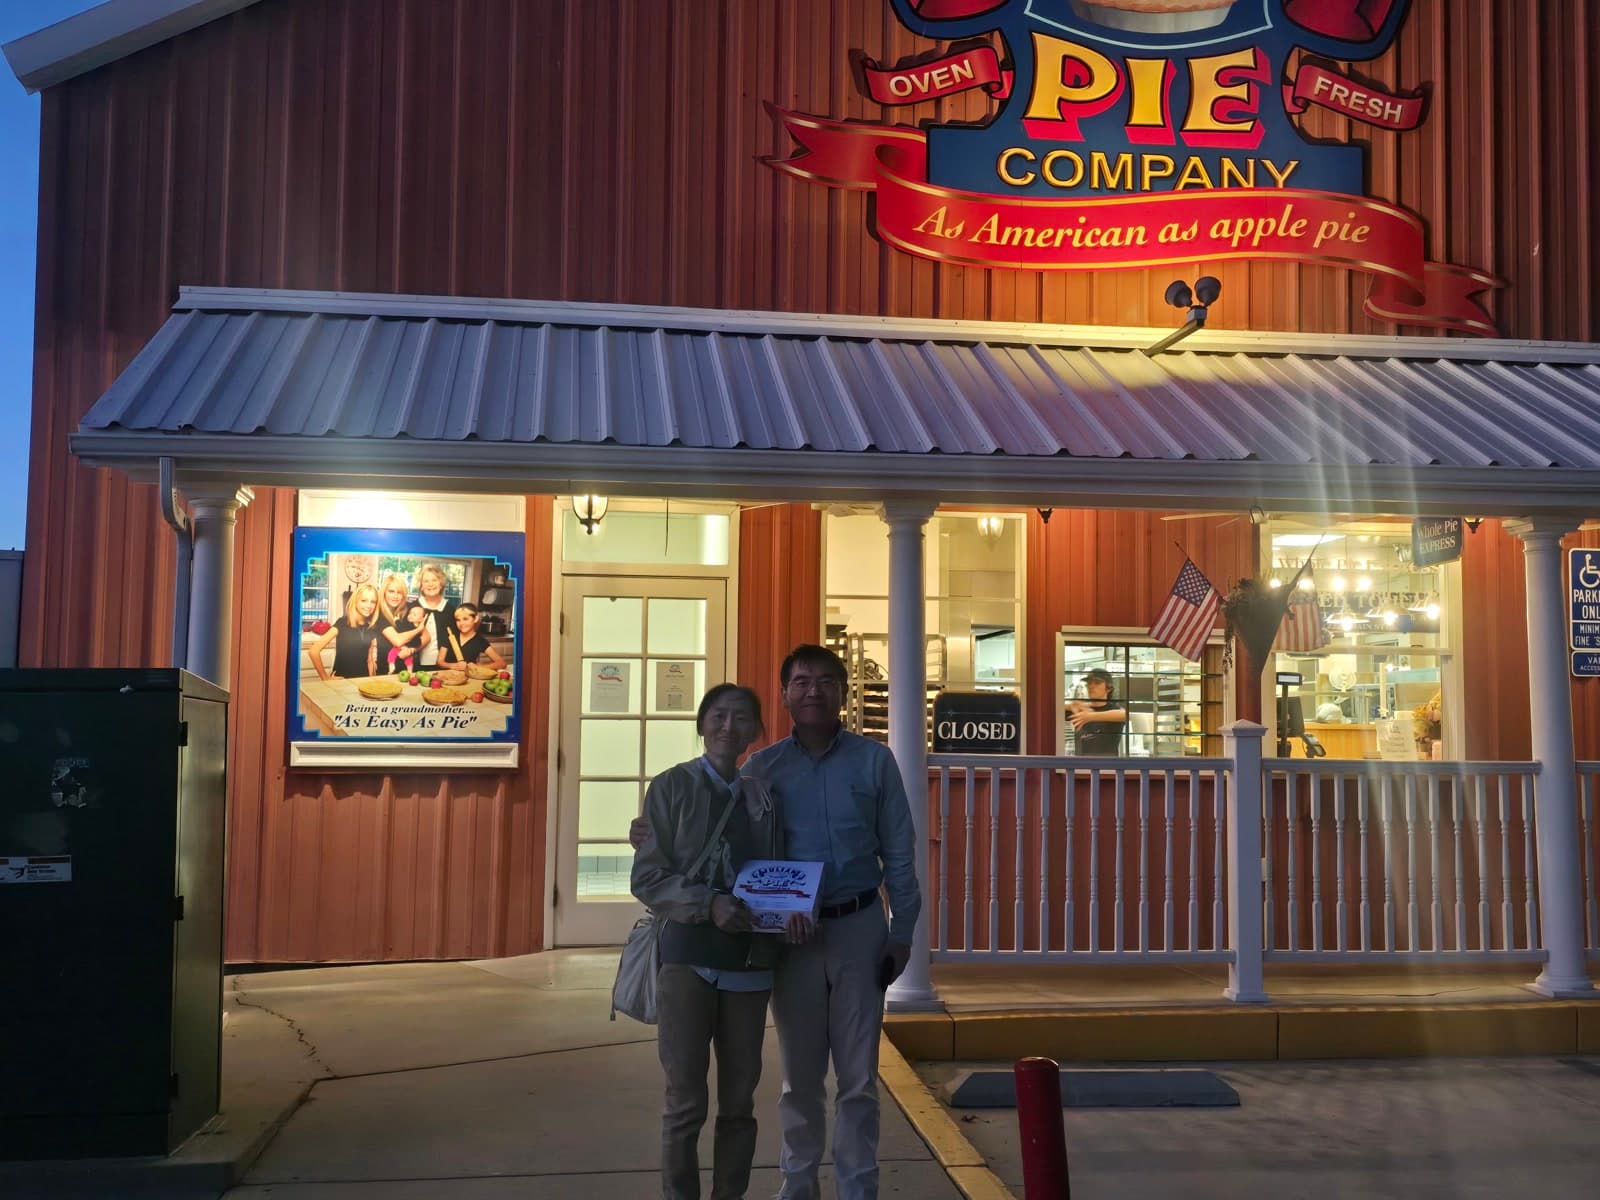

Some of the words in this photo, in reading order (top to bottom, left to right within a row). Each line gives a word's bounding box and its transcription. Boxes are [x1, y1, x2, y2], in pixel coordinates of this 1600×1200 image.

[889, 59, 976, 97] OVEN
[1023, 31, 1262, 137] PIE
[1313, 76, 1403, 124] FRESH
[996, 147, 1300, 191] COMPANY
[913, 206, 965, 239] As
[968, 213, 1148, 248] American
[1158, 219, 1198, 243] as
[1209, 204, 1307, 248] apple
[1312, 212, 1370, 248] pie
[1416, 520, 1442, 538] Whole
[1444, 519, 1459, 534] Pie
[1419, 536, 1456, 553] EXPRESS
[1575, 635, 1590, 646] FINE
[1587, 656, 1600, 665] VA
[345, 704, 379, 715] Being
[381, 705, 389, 713] a
[334, 715, 361, 729] "As
[366, 715, 409, 732] Easy
[412, 715, 436, 729] As
[440, 715, 478, 729] Pie"
[937, 721, 1017, 741] CLOSED
